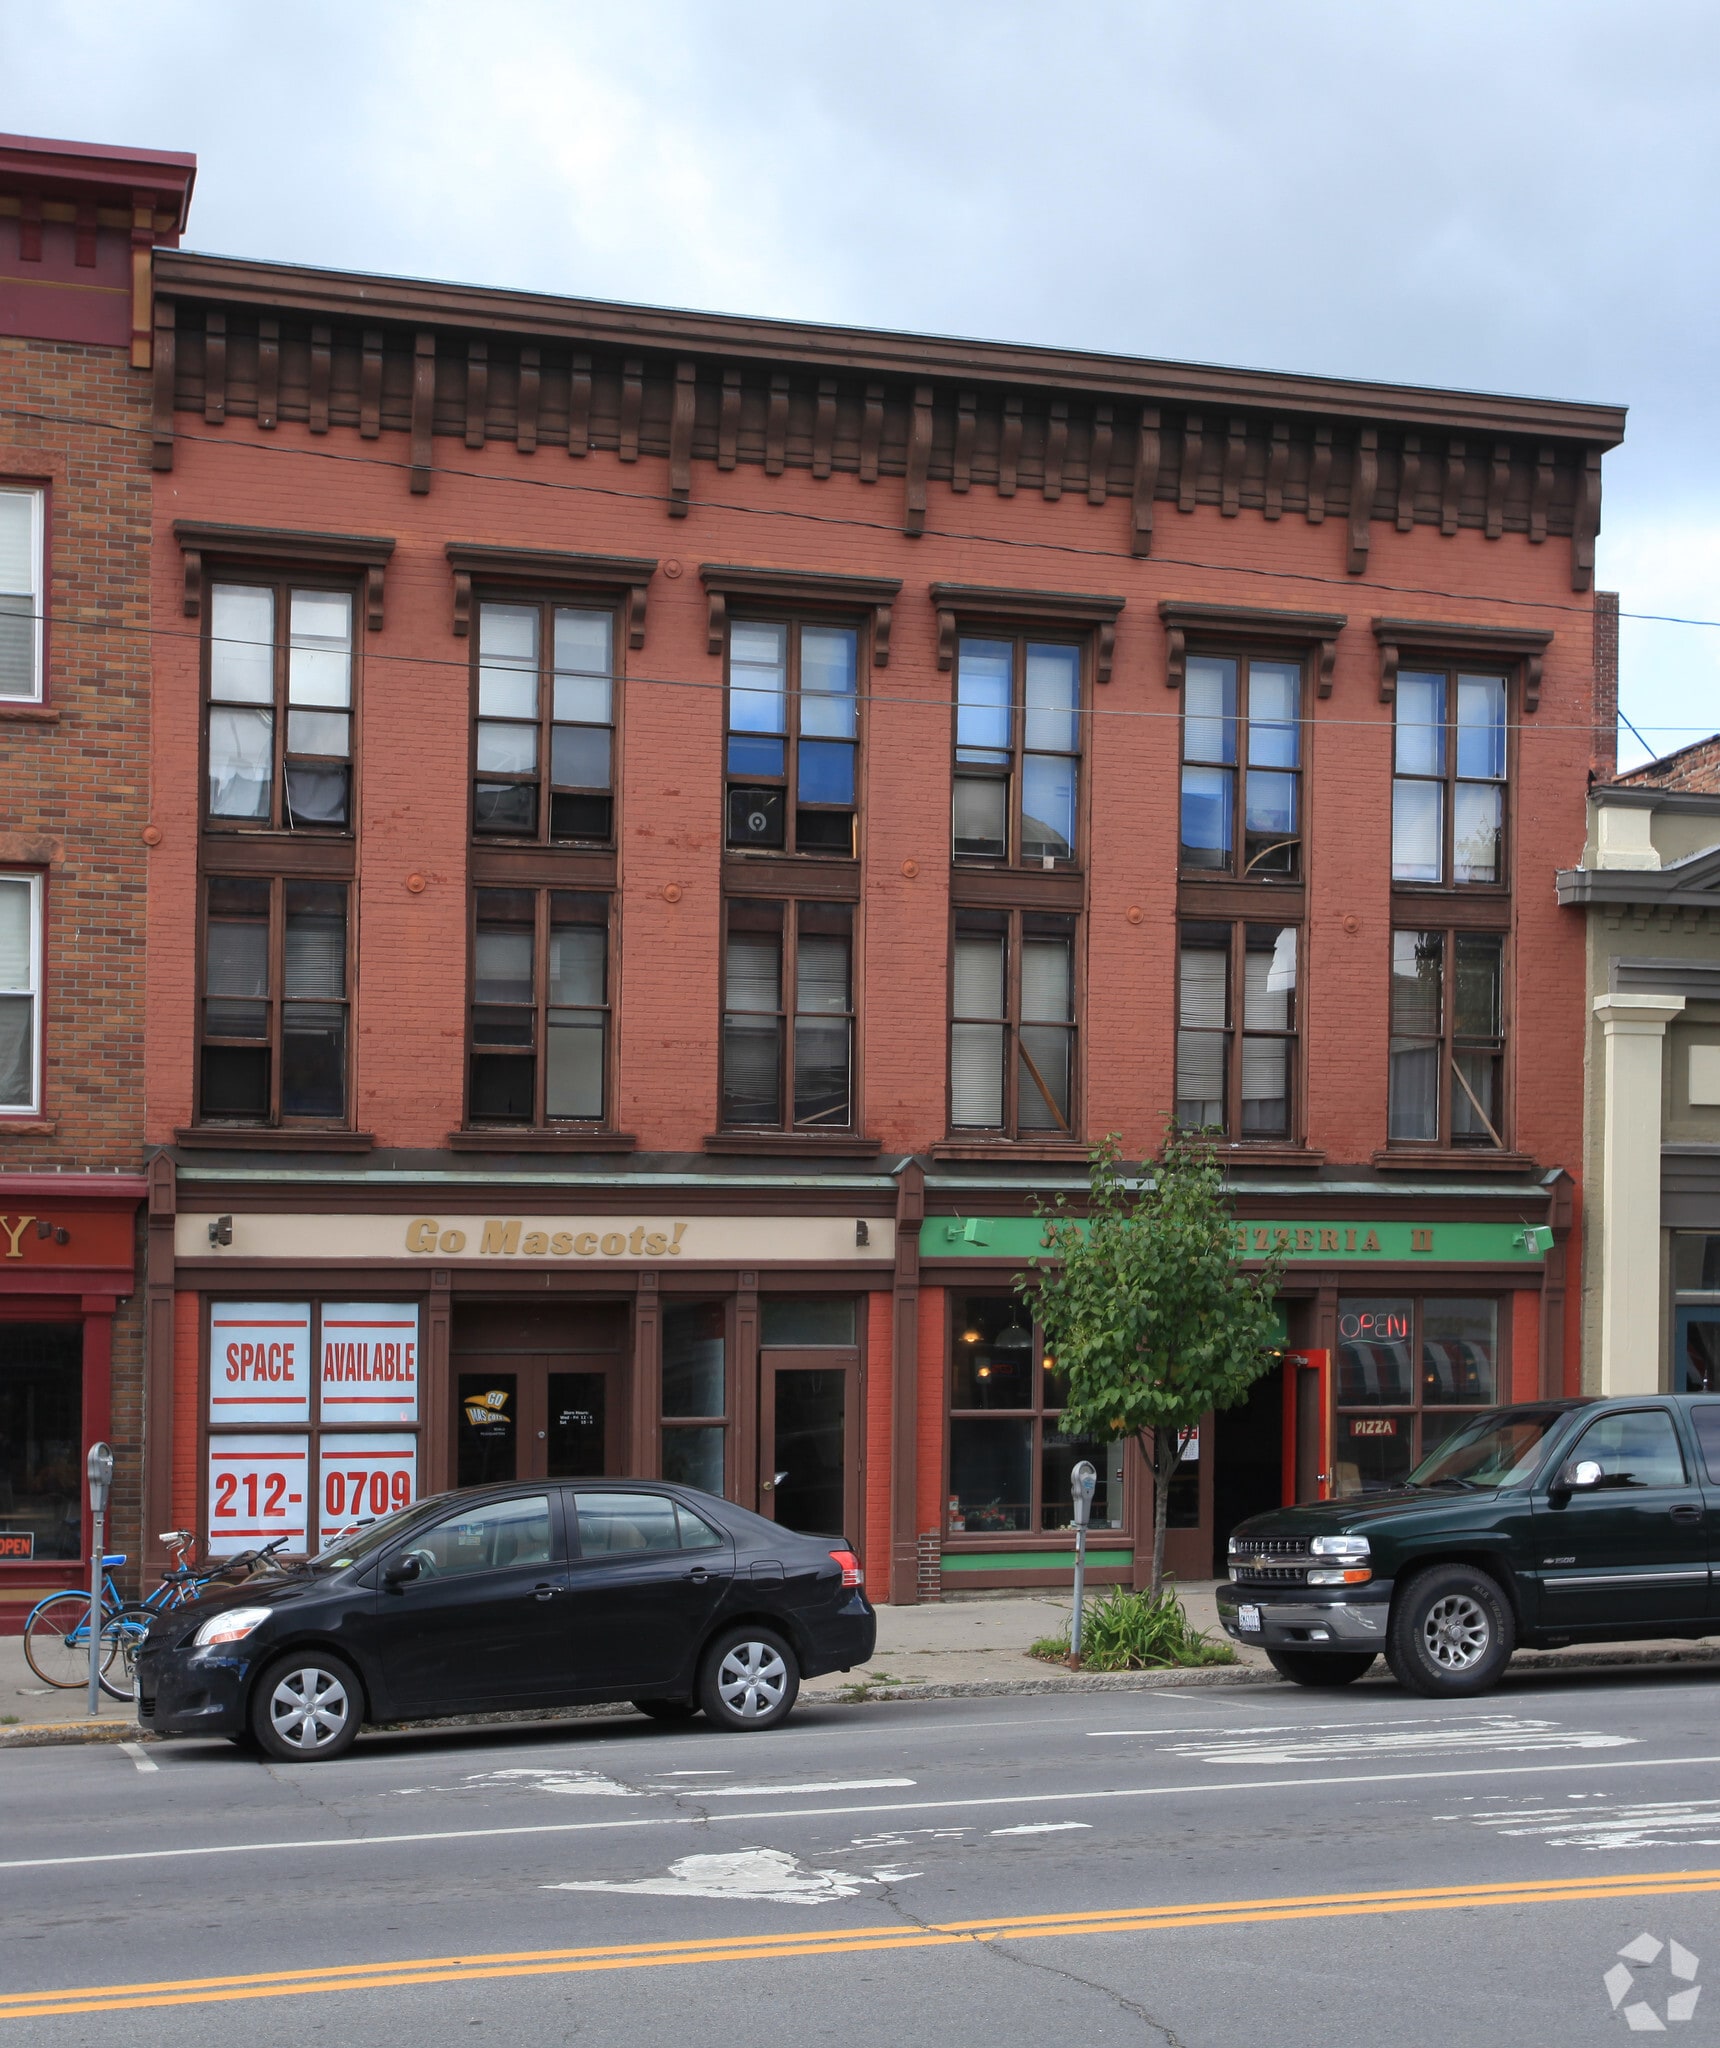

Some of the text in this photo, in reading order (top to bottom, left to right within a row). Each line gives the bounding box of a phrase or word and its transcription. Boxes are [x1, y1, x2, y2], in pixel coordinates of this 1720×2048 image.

[405, 1218, 688, 1255] Go Mascots!
[1340, 1313, 1408, 1338] OPEN
[226, 1343, 415, 1382] SPACE AVAILABLE
[487, 1392, 504, 1406] GO
[1355, 1420, 1393, 1434] PIZZA
[214, 1470, 411, 1517] 212- 0709
[0, 1538, 30, 1555] OPEN
